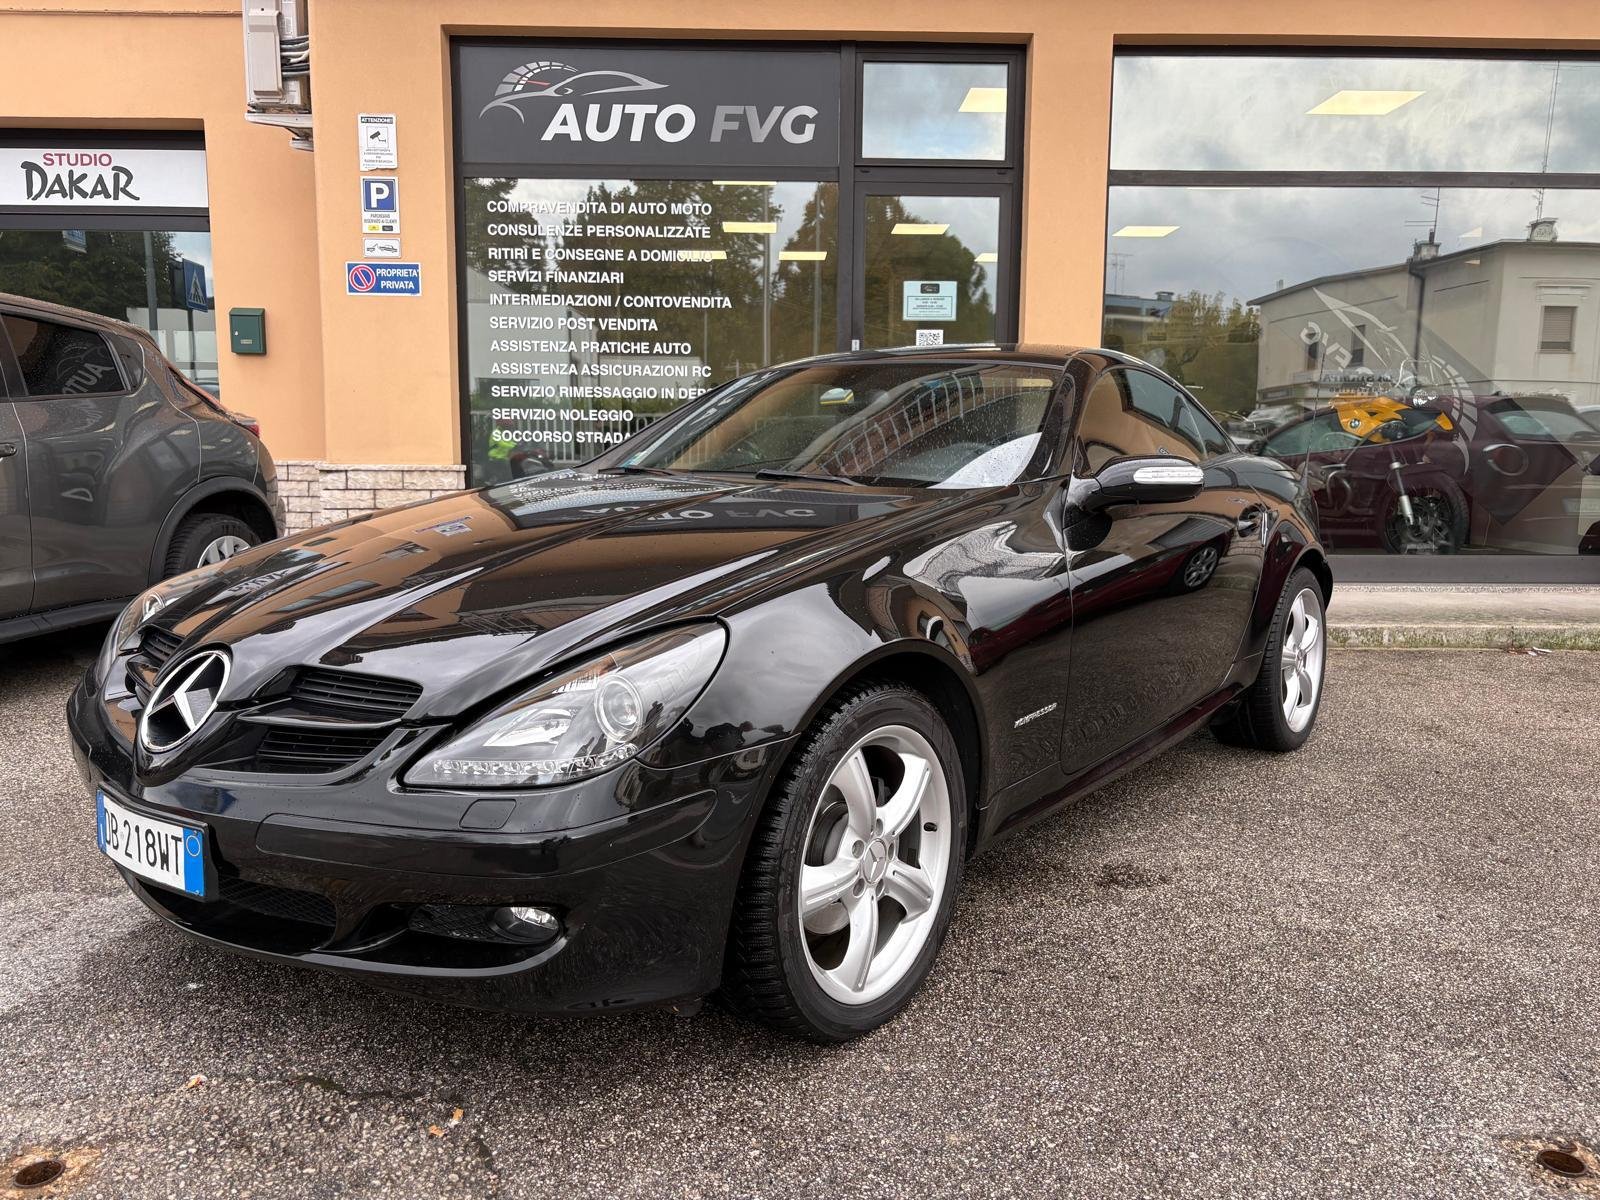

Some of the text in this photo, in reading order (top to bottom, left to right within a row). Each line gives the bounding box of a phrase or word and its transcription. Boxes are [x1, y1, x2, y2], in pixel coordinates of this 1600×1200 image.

[541, 103, 820, 145] AUTO FVG
[42, 152, 113, 167] STUDIO
[20, 160, 141, 202] DAKAR
[370, 182, 390, 209] P
[486, 200, 712, 216] COMPRAVENDITA DI AUTO MOTO
[487, 223, 711, 239] CONSULENZE PERSONALIZZATE
[487, 247, 713, 263] RITIRI E CONSEGNE A DOMICILIO
[487, 270, 625, 284] SERVIZI FINANZIARI
[380, 281, 415, 289] PRIVATA
[489, 293, 612, 308] INTERMEDIAZIONI
[623, 295, 733, 309] CONTOVENDITA
[489, 317, 659, 332] SERVIZIO POST VENDITA
[490, 340, 692, 355] ASSISTENZA PRATICHE AUTO
[490, 363, 712, 378] ASSISTENZA ASSICURAZIONI RC
[491, 385, 556, 398] SERVIZIO
[559, 386, 658, 399] RIMESSAGGIO
[660, 387, 675, 399] IN
[491, 408, 634, 422] SERVIZIO NOLEGGIO
[491, 430, 573, 443] SOCCORSO
